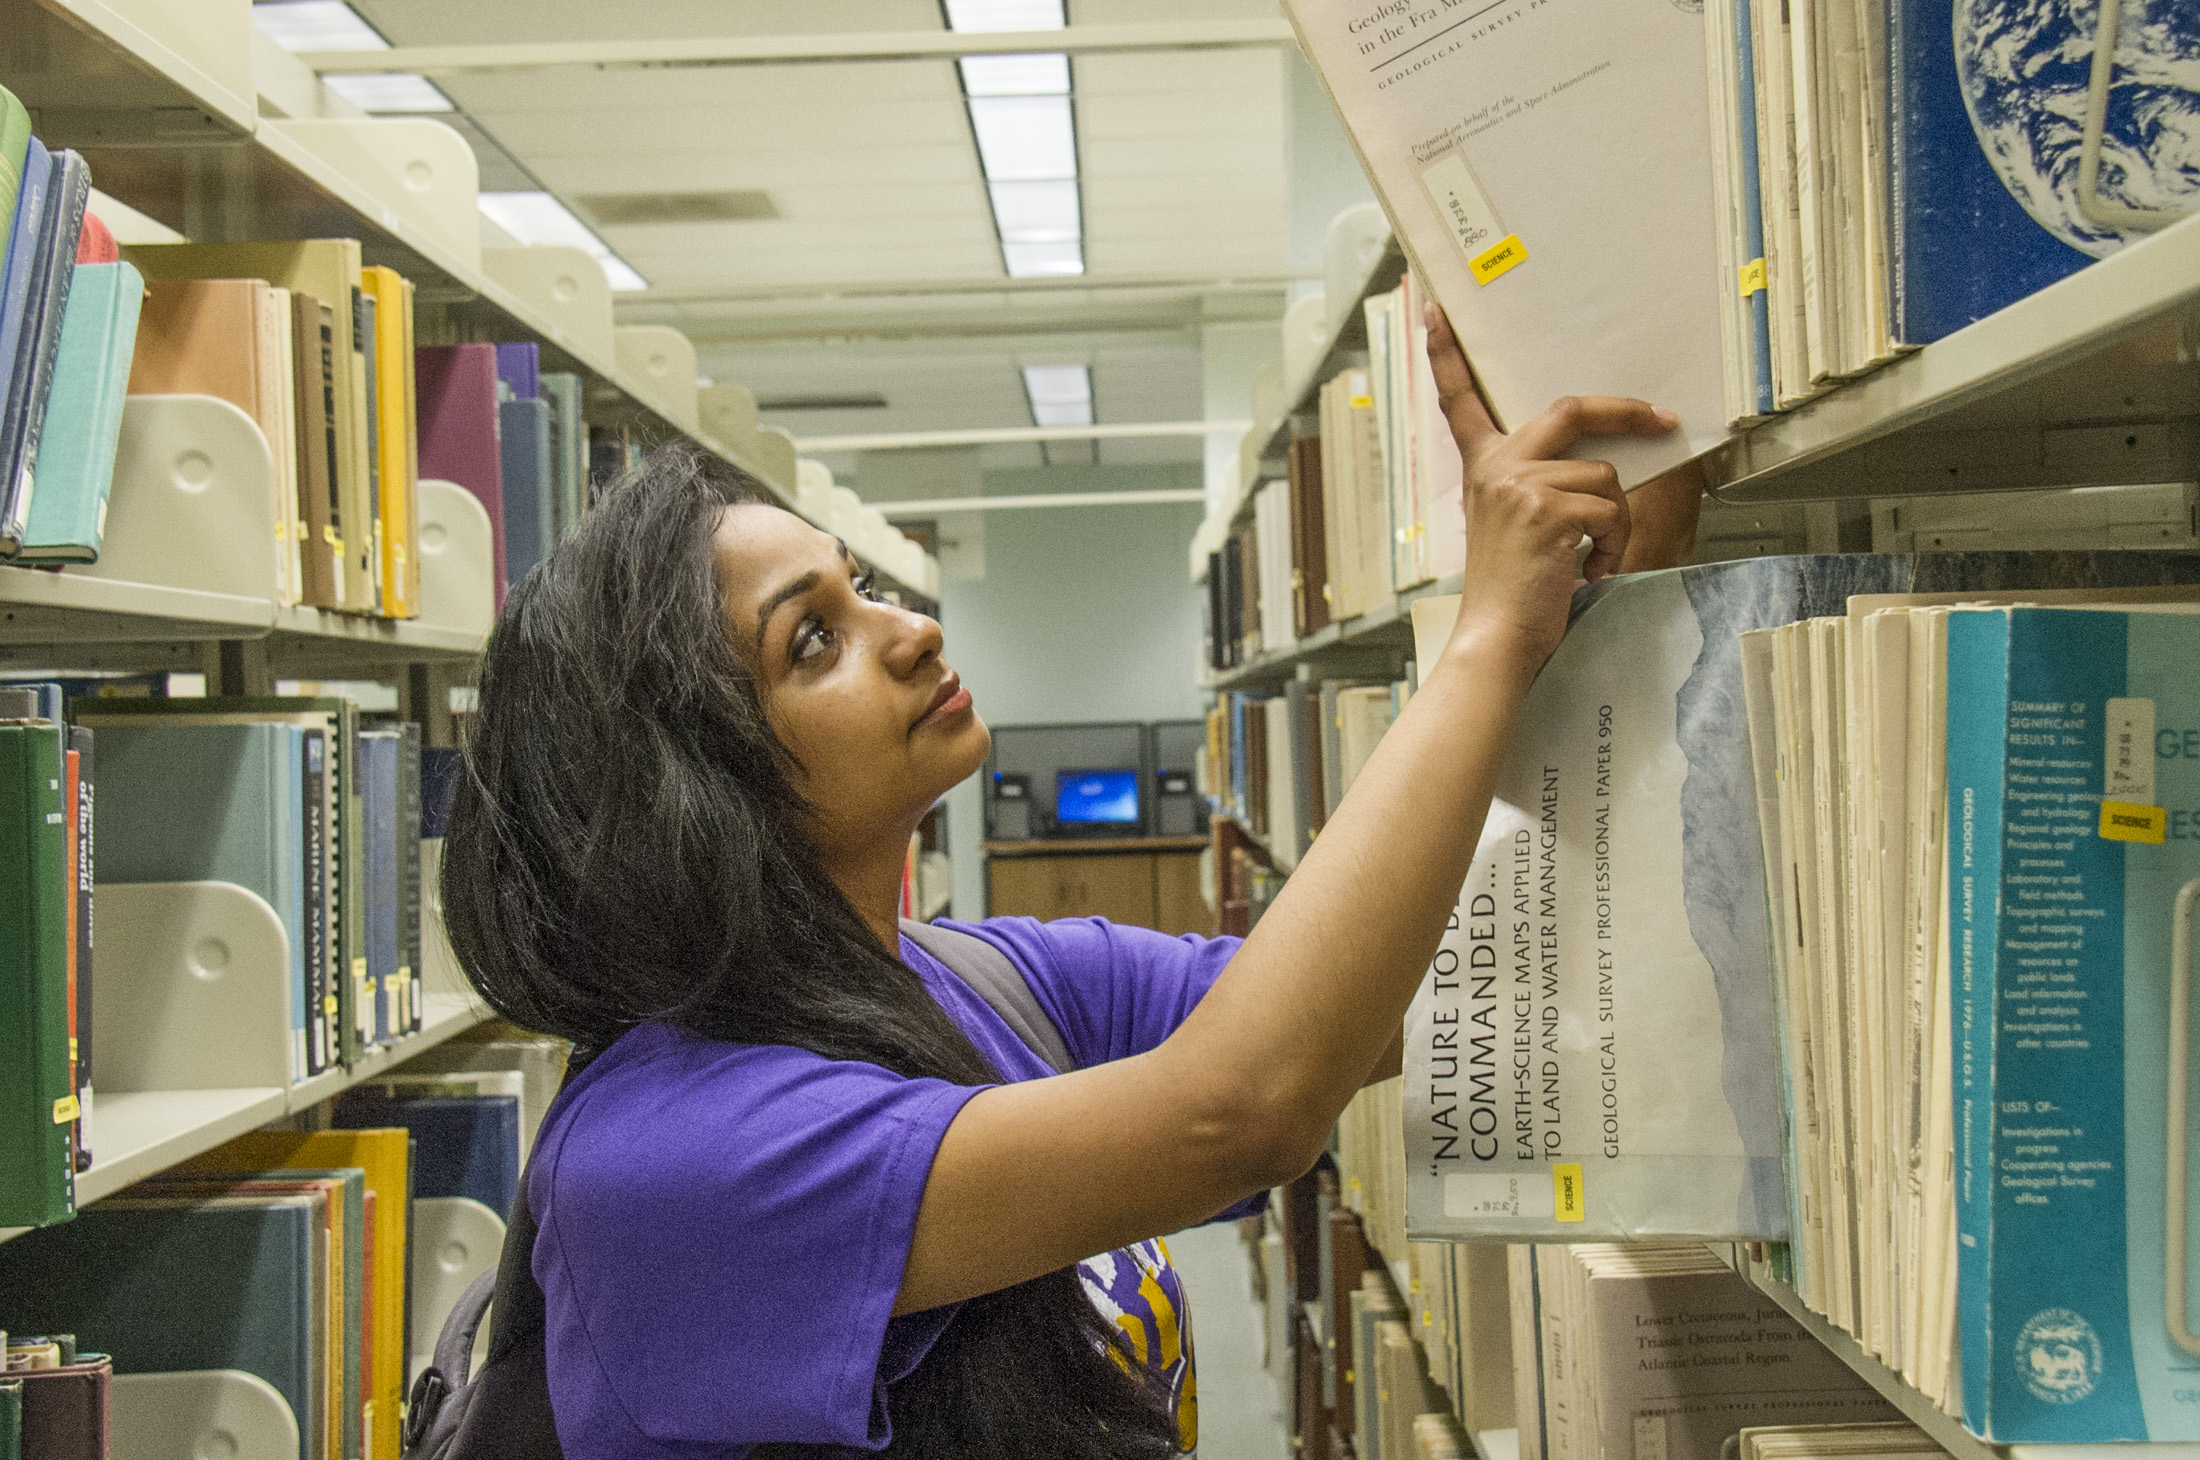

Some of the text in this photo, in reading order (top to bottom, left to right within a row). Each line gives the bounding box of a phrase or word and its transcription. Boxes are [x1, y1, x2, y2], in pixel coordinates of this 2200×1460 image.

[1357, 41, 1377, 56] in
[1379, 24, 1406, 45] the
[1408, 8, 1438, 29] Fra
[1378, 41, 1464, 90] GEOLOGICAL
[1471, 9, 1522, 41] SURVEY
[1416, 61, 1612, 165] National Aeronautics and Space Administration
[1411, 96, 1515, 154] Prepared on behalf of the
[1464, 228, 1488, 248] 880
[1481, 247, 1515, 272] SCIENCE
[2011, 701, 2086, 714] SUMMARY OF
[2010, 718, 2086, 730] SIGNIFICANT
[2009, 735, 2055, 746] RESULTS
[2009, 757, 2092, 769] Mineral resources
[2009, 774, 2086, 785] Water resources
[2008, 789, 2064, 803] Engineering
[2020, 807, 2090, 820] and hydrology
[1963, 787, 1974, 868] GEOLOGICAL
[2111, 813, 2152, 830] SCIENCE
[79, 781, 88, 891] of the world
[2008, 823, 2092, 836] Regional geology
[2055, 840, 2074, 850] and
[2019, 858, 2065, 868] processes
[2007, 874, 2080, 886] Laboratory and
[1963, 876, 1973, 922] SURVEY
[2043, 891, 2084, 900] methods
[2006, 906, 2105, 918] Topographic surveys
[1595, 705, 1619, 1159] GEOLOGICAL SURVEY PROFESSIONAL PAPER 950
[2018, 924, 2083, 936] and mapping
[2006, 939, 2082, 951] Management of
[1539, 765, 1562, 1161] TO LAND AND WATER MANAGEMENT
[1963, 929, 1973, 991] RESEARCH
[2018, 957, 2062, 967] resources
[1432, 947, 1461, 995] TO
[2017, 972, 2046, 983] public
[1513, 828, 1534, 1161] EARTH-SCIENCE MAPS APPLIED
[2004, 989, 2028, 999] Land
[2017, 1005, 2079, 1017] and analysis
[2004, 1022, 2082, 1033] Investigations in
[2016, 1038, 2089, 1048] other countries
[2002, 1102, 2029, 1113] LISTS
[1963, 1099, 1973, 1167] Professional
[2002, 1127, 2082, 1138] Investigations in
[2016, 1144, 2058, 1155] progress
[2002, 1159, 2112, 1171] Cooperating agencies
[2002, 1176, 2096, 1188] Geological Survey
[1563, 1175, 1574, 1211] SCIENCE
[2015, 1193, 2048, 1204] offices
[1636, 1314, 1675, 1328] Lower
[1757, 1329, 1793, 1342] From
[1638, 1351, 1791, 1371] Atlantic Coastal Region
